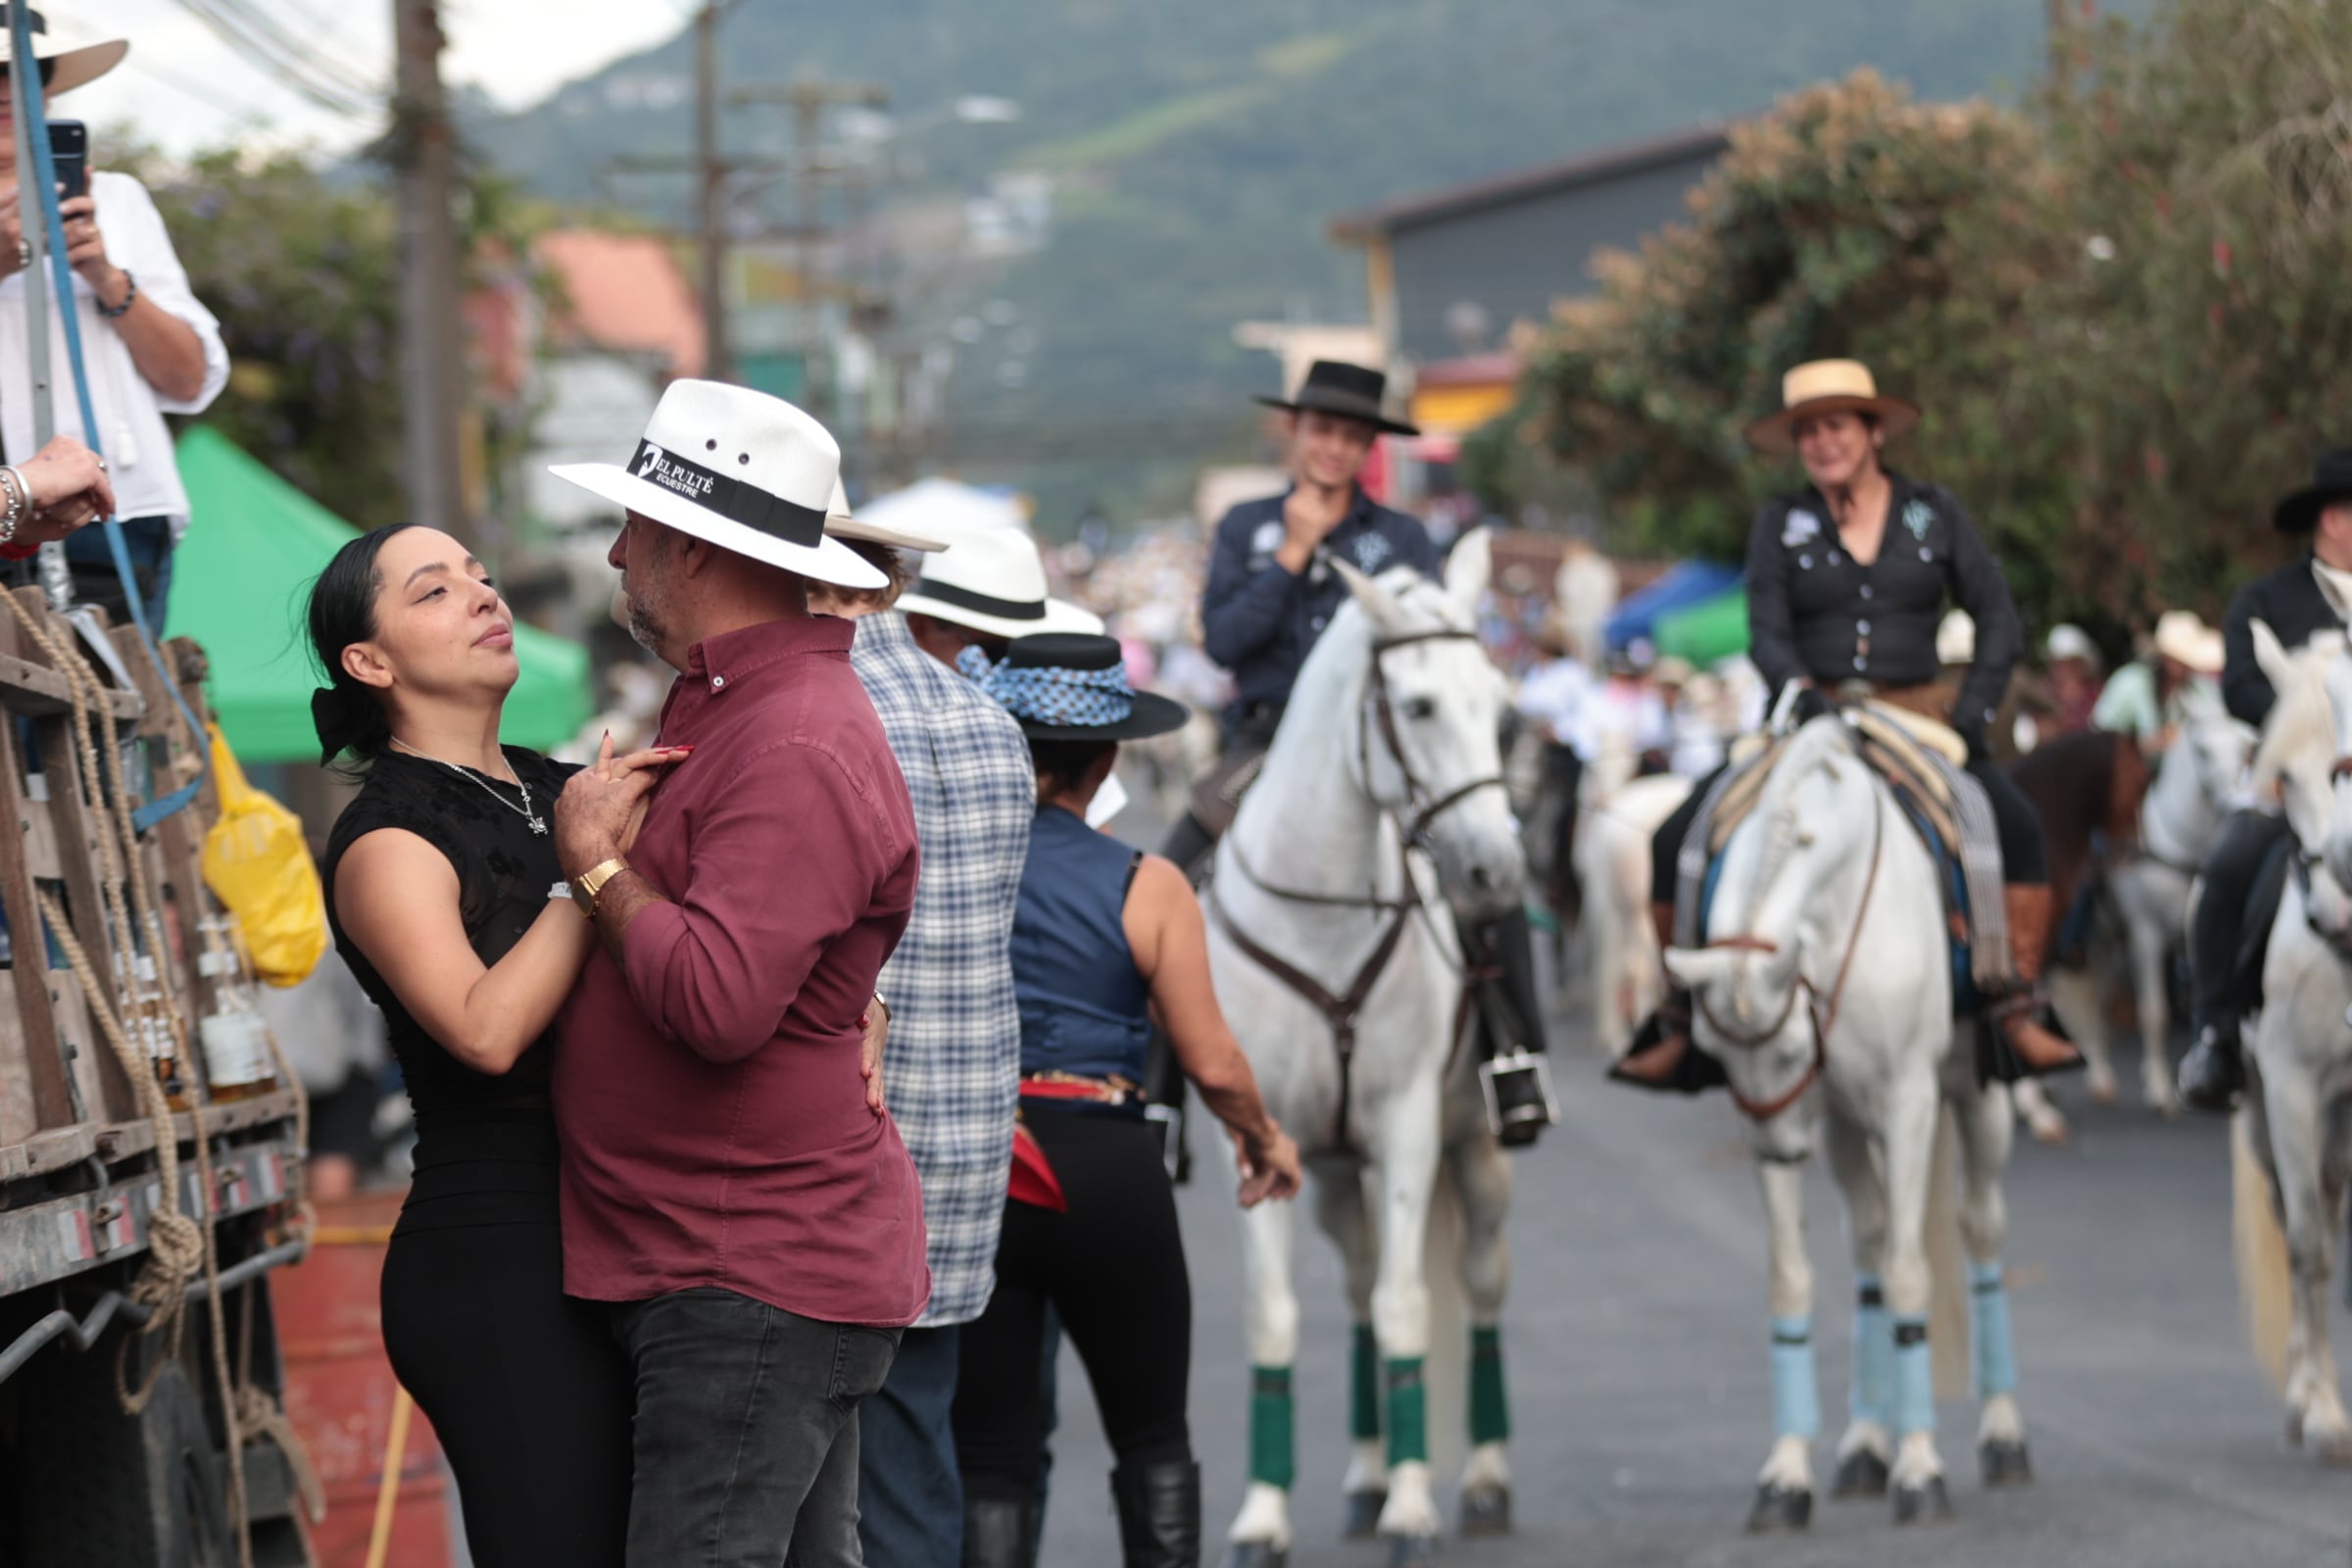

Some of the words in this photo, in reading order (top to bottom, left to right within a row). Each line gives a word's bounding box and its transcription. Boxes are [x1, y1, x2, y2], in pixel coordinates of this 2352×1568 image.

[656, 458, 670, 475] EL
[671, 465, 713, 494] PULTÉ
[657, 473, 698, 498] ECUESTRE
